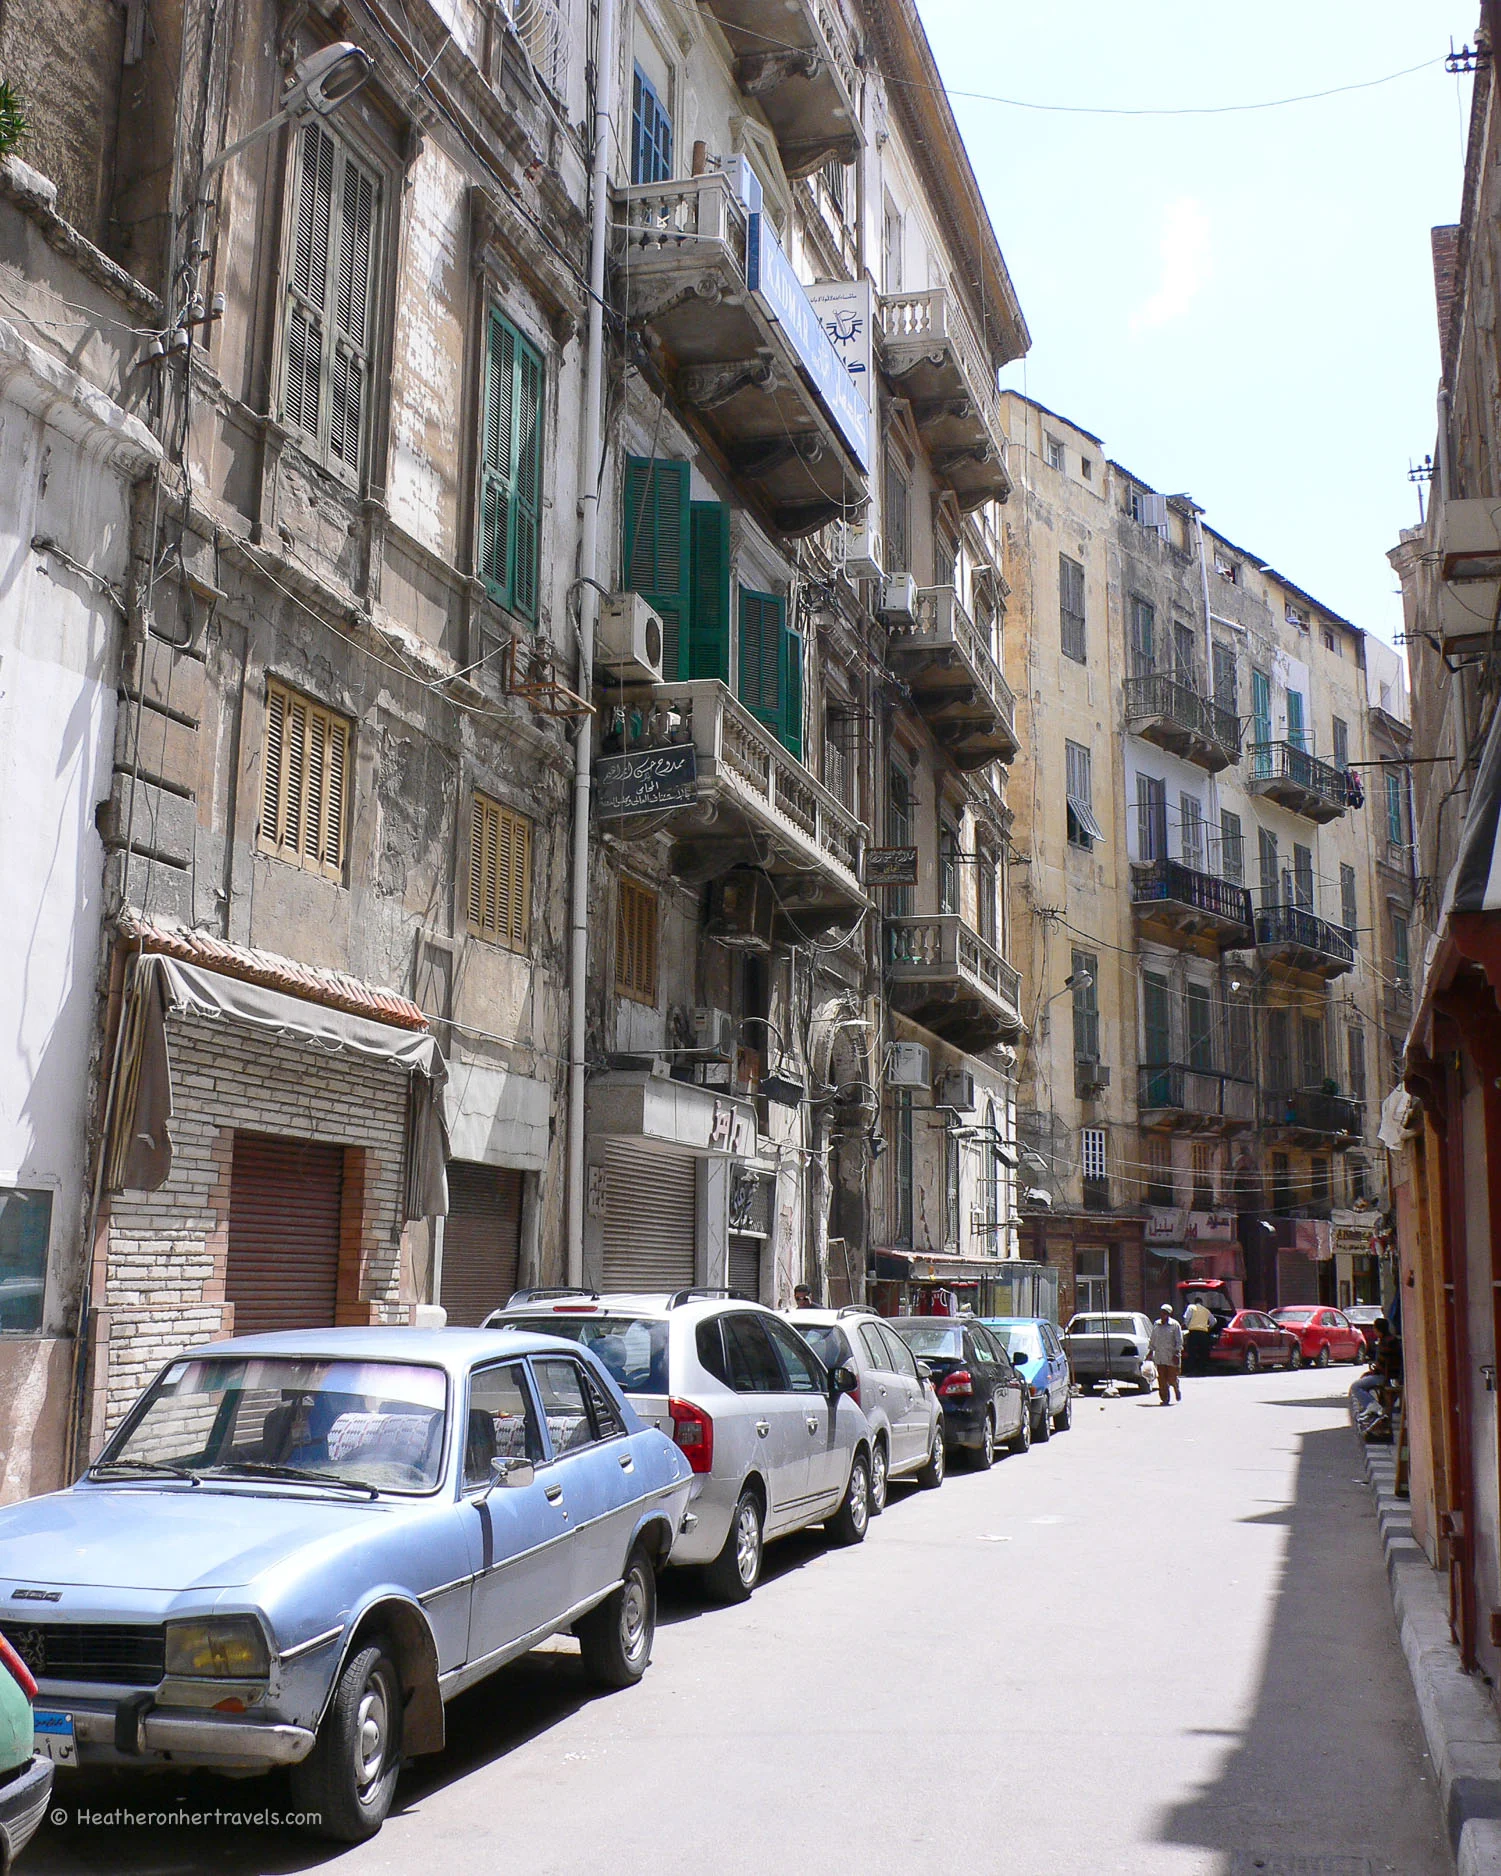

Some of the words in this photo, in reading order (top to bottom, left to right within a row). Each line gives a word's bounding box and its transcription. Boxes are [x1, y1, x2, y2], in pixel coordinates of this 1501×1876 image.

[767, 245, 809, 350] KADMAR
[633, 757, 656, 778] حسن
[655, 758, 685, 777] ممدوح
